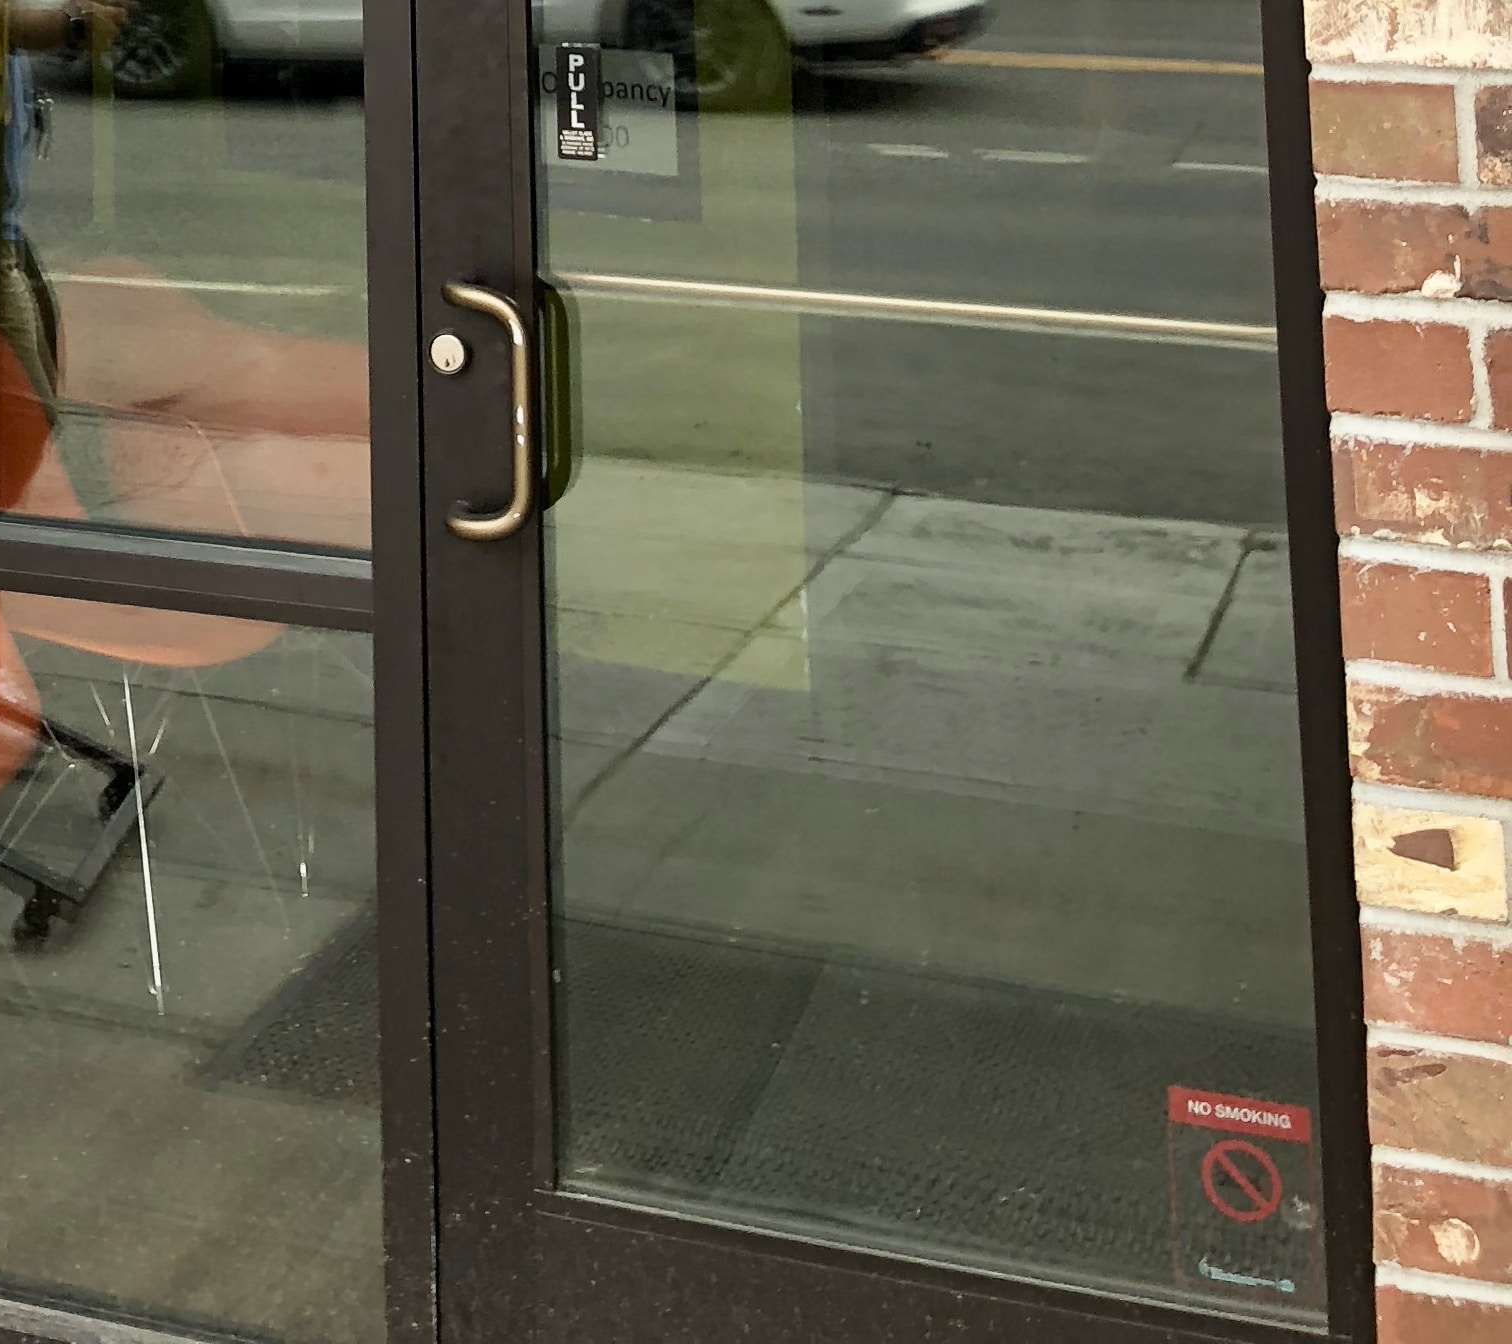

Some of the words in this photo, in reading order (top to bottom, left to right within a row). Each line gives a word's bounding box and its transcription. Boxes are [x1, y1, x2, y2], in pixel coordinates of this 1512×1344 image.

[541, 71, 672, 108] Opancy
[568, 53, 585, 129] PULL
[1188, 1099, 1212, 1116] NO
[1214, 1103, 1292, 1130] SMOKING
